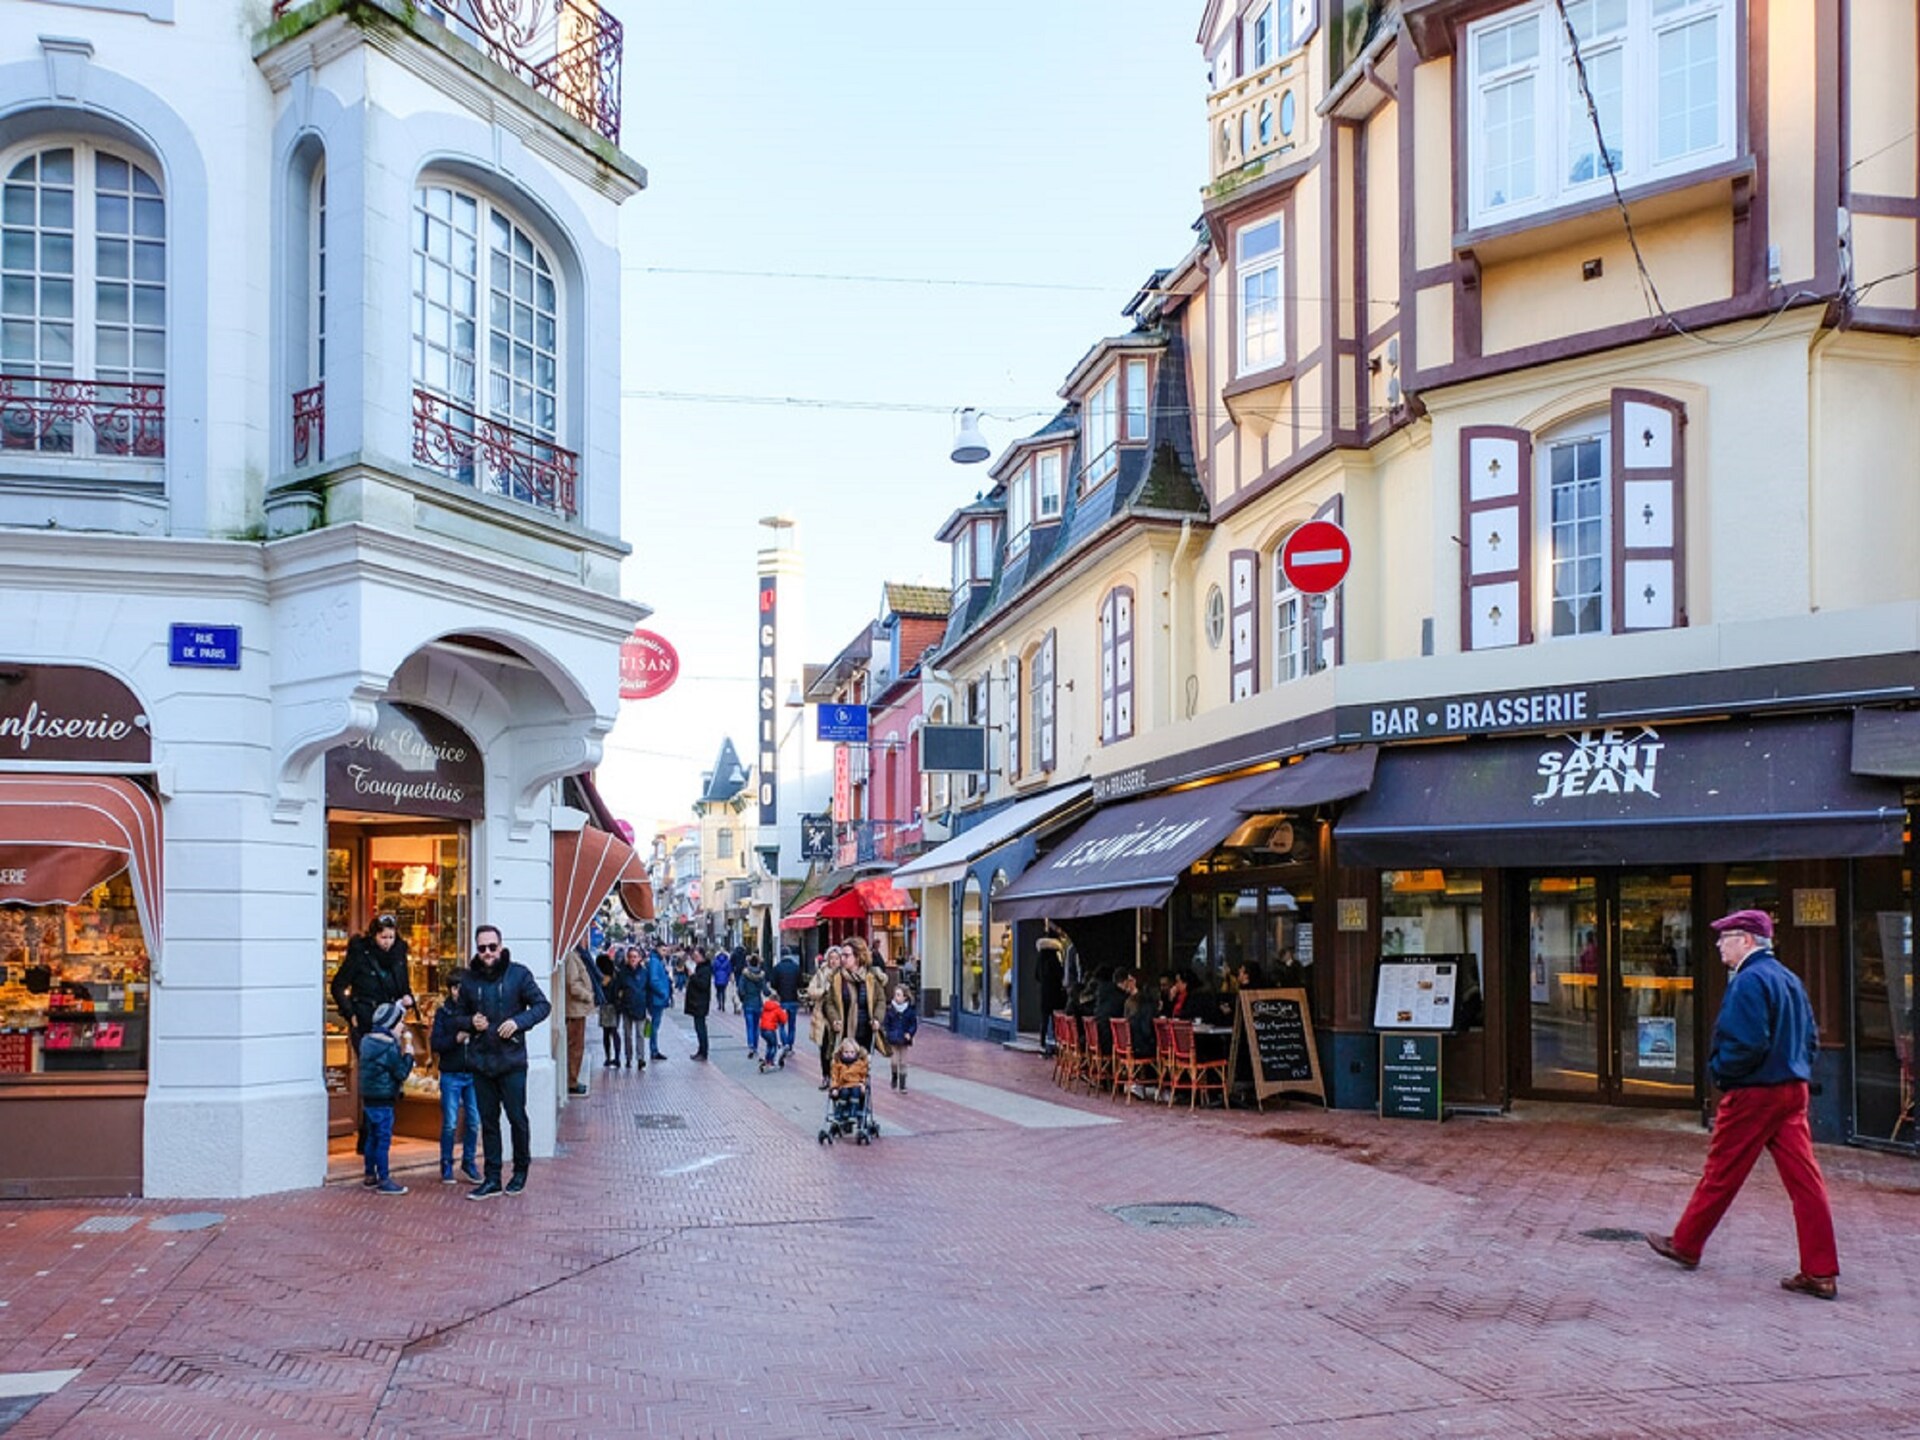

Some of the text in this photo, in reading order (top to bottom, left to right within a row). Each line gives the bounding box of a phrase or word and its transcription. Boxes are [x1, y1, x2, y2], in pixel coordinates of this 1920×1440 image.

[183, 646, 226, 660] DE PARIS
[195, 633, 215, 645] RUE
[0, 701, 131, 750] nfiserie
[1372, 691, 1587, 736] BAR BRASSERIE
[391, 728, 467, 764] Caprice
[1580, 731, 1624, 747] LE
[1537, 743, 1665, 776] SAINT
[347, 763, 464, 806] Touquettois
[1111, 769, 1147, 794] BRASSERIE
[1532, 768, 1657, 799] JEAN
[0, 868, 27, 885] ERIE
